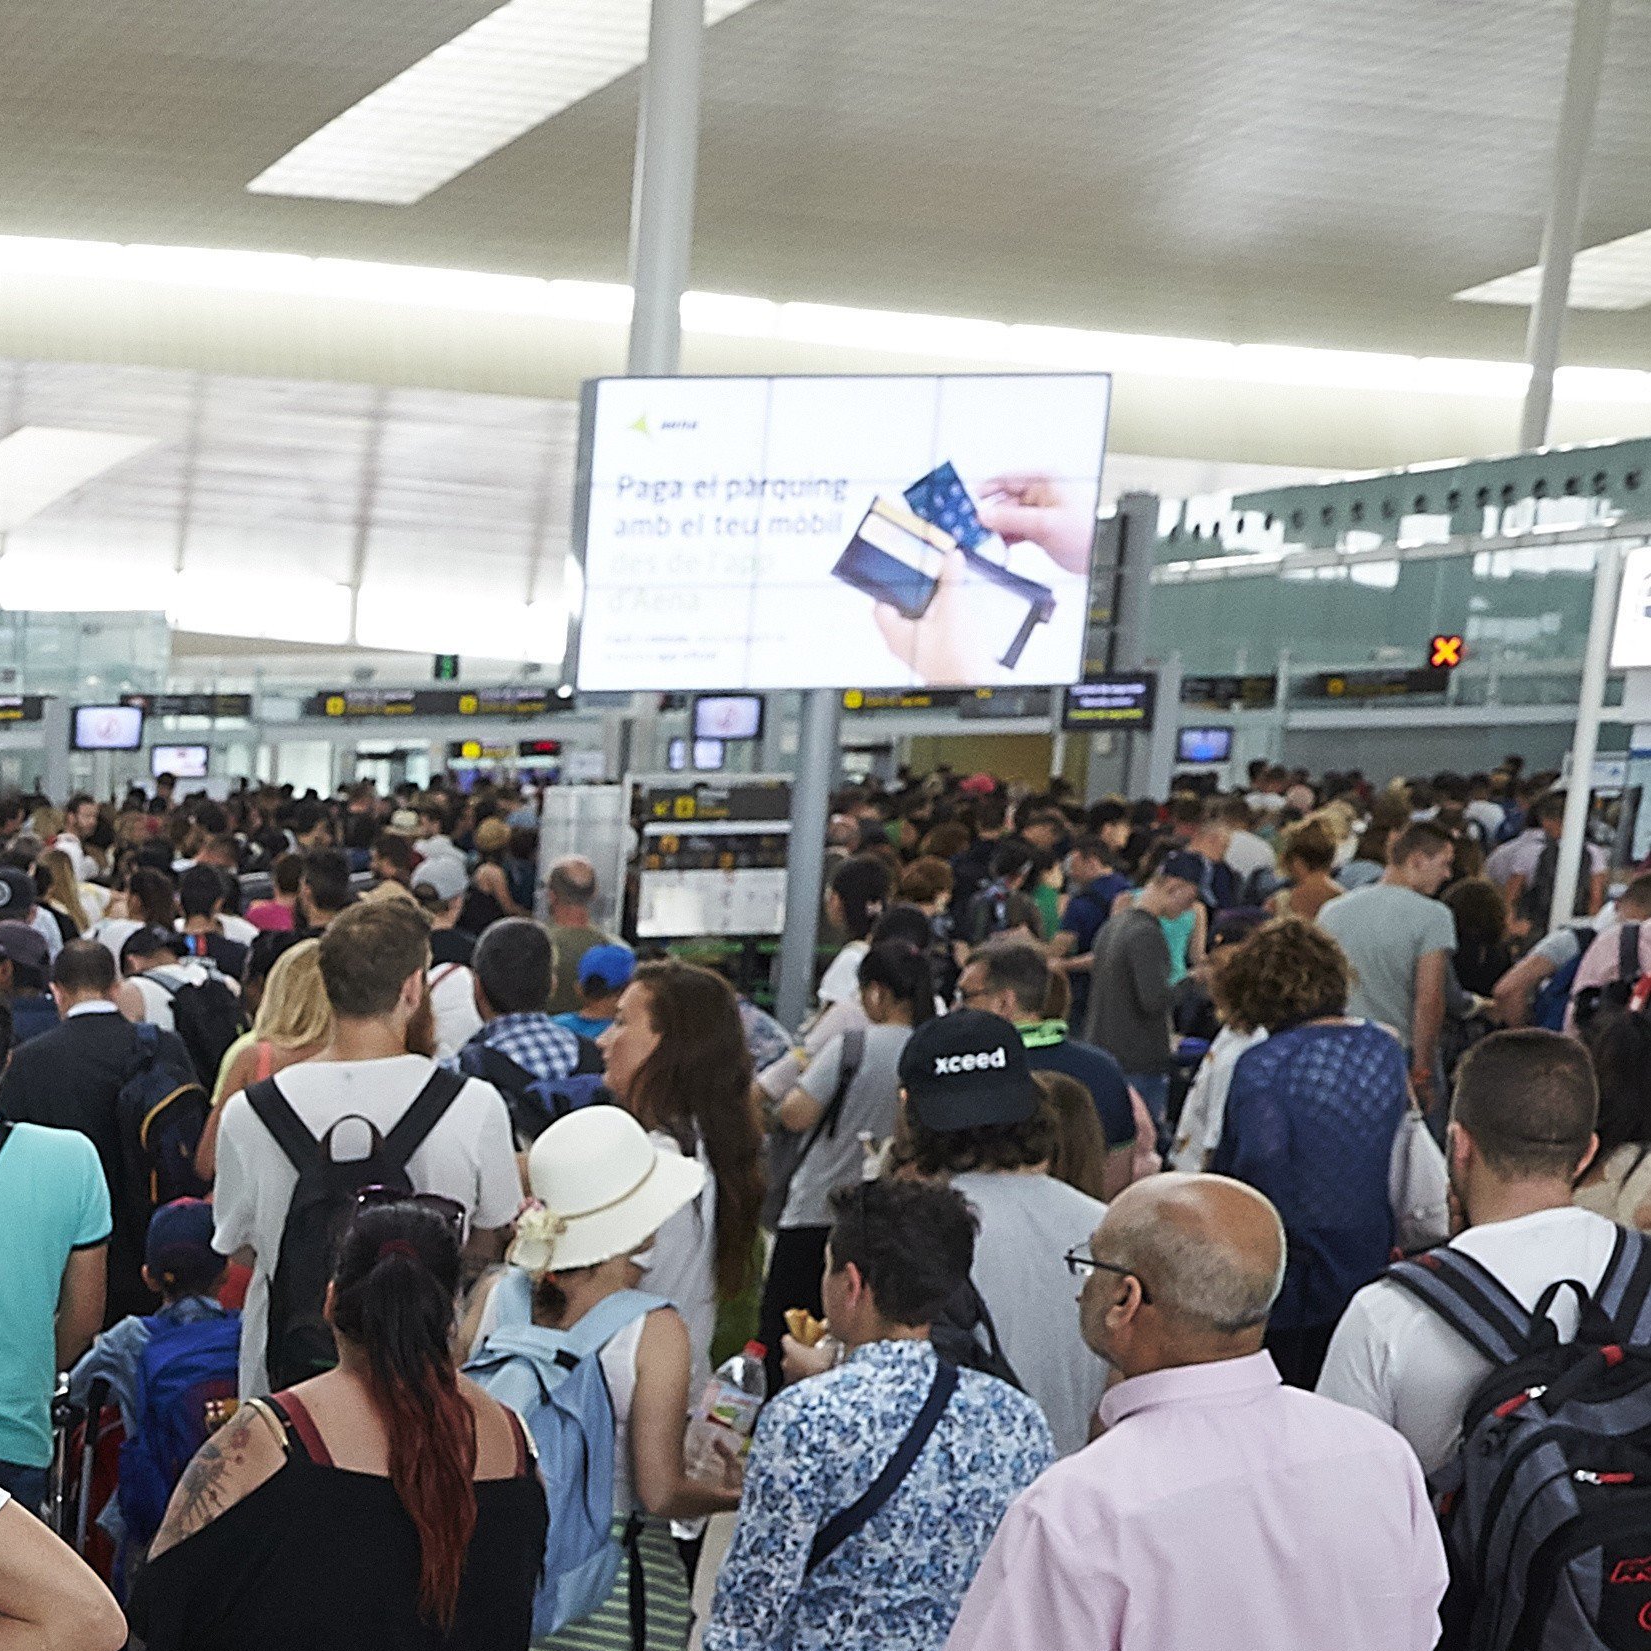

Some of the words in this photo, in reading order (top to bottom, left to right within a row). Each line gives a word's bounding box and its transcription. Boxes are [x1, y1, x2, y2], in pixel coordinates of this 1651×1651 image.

[617, 474, 683, 505] Paga
[694, 472, 718, 499] el
[614, 514, 671, 538] amb
[681, 512, 704, 537] el
[714, 514, 759, 536] teu
[934, 1045, 1007, 1077] xceed
